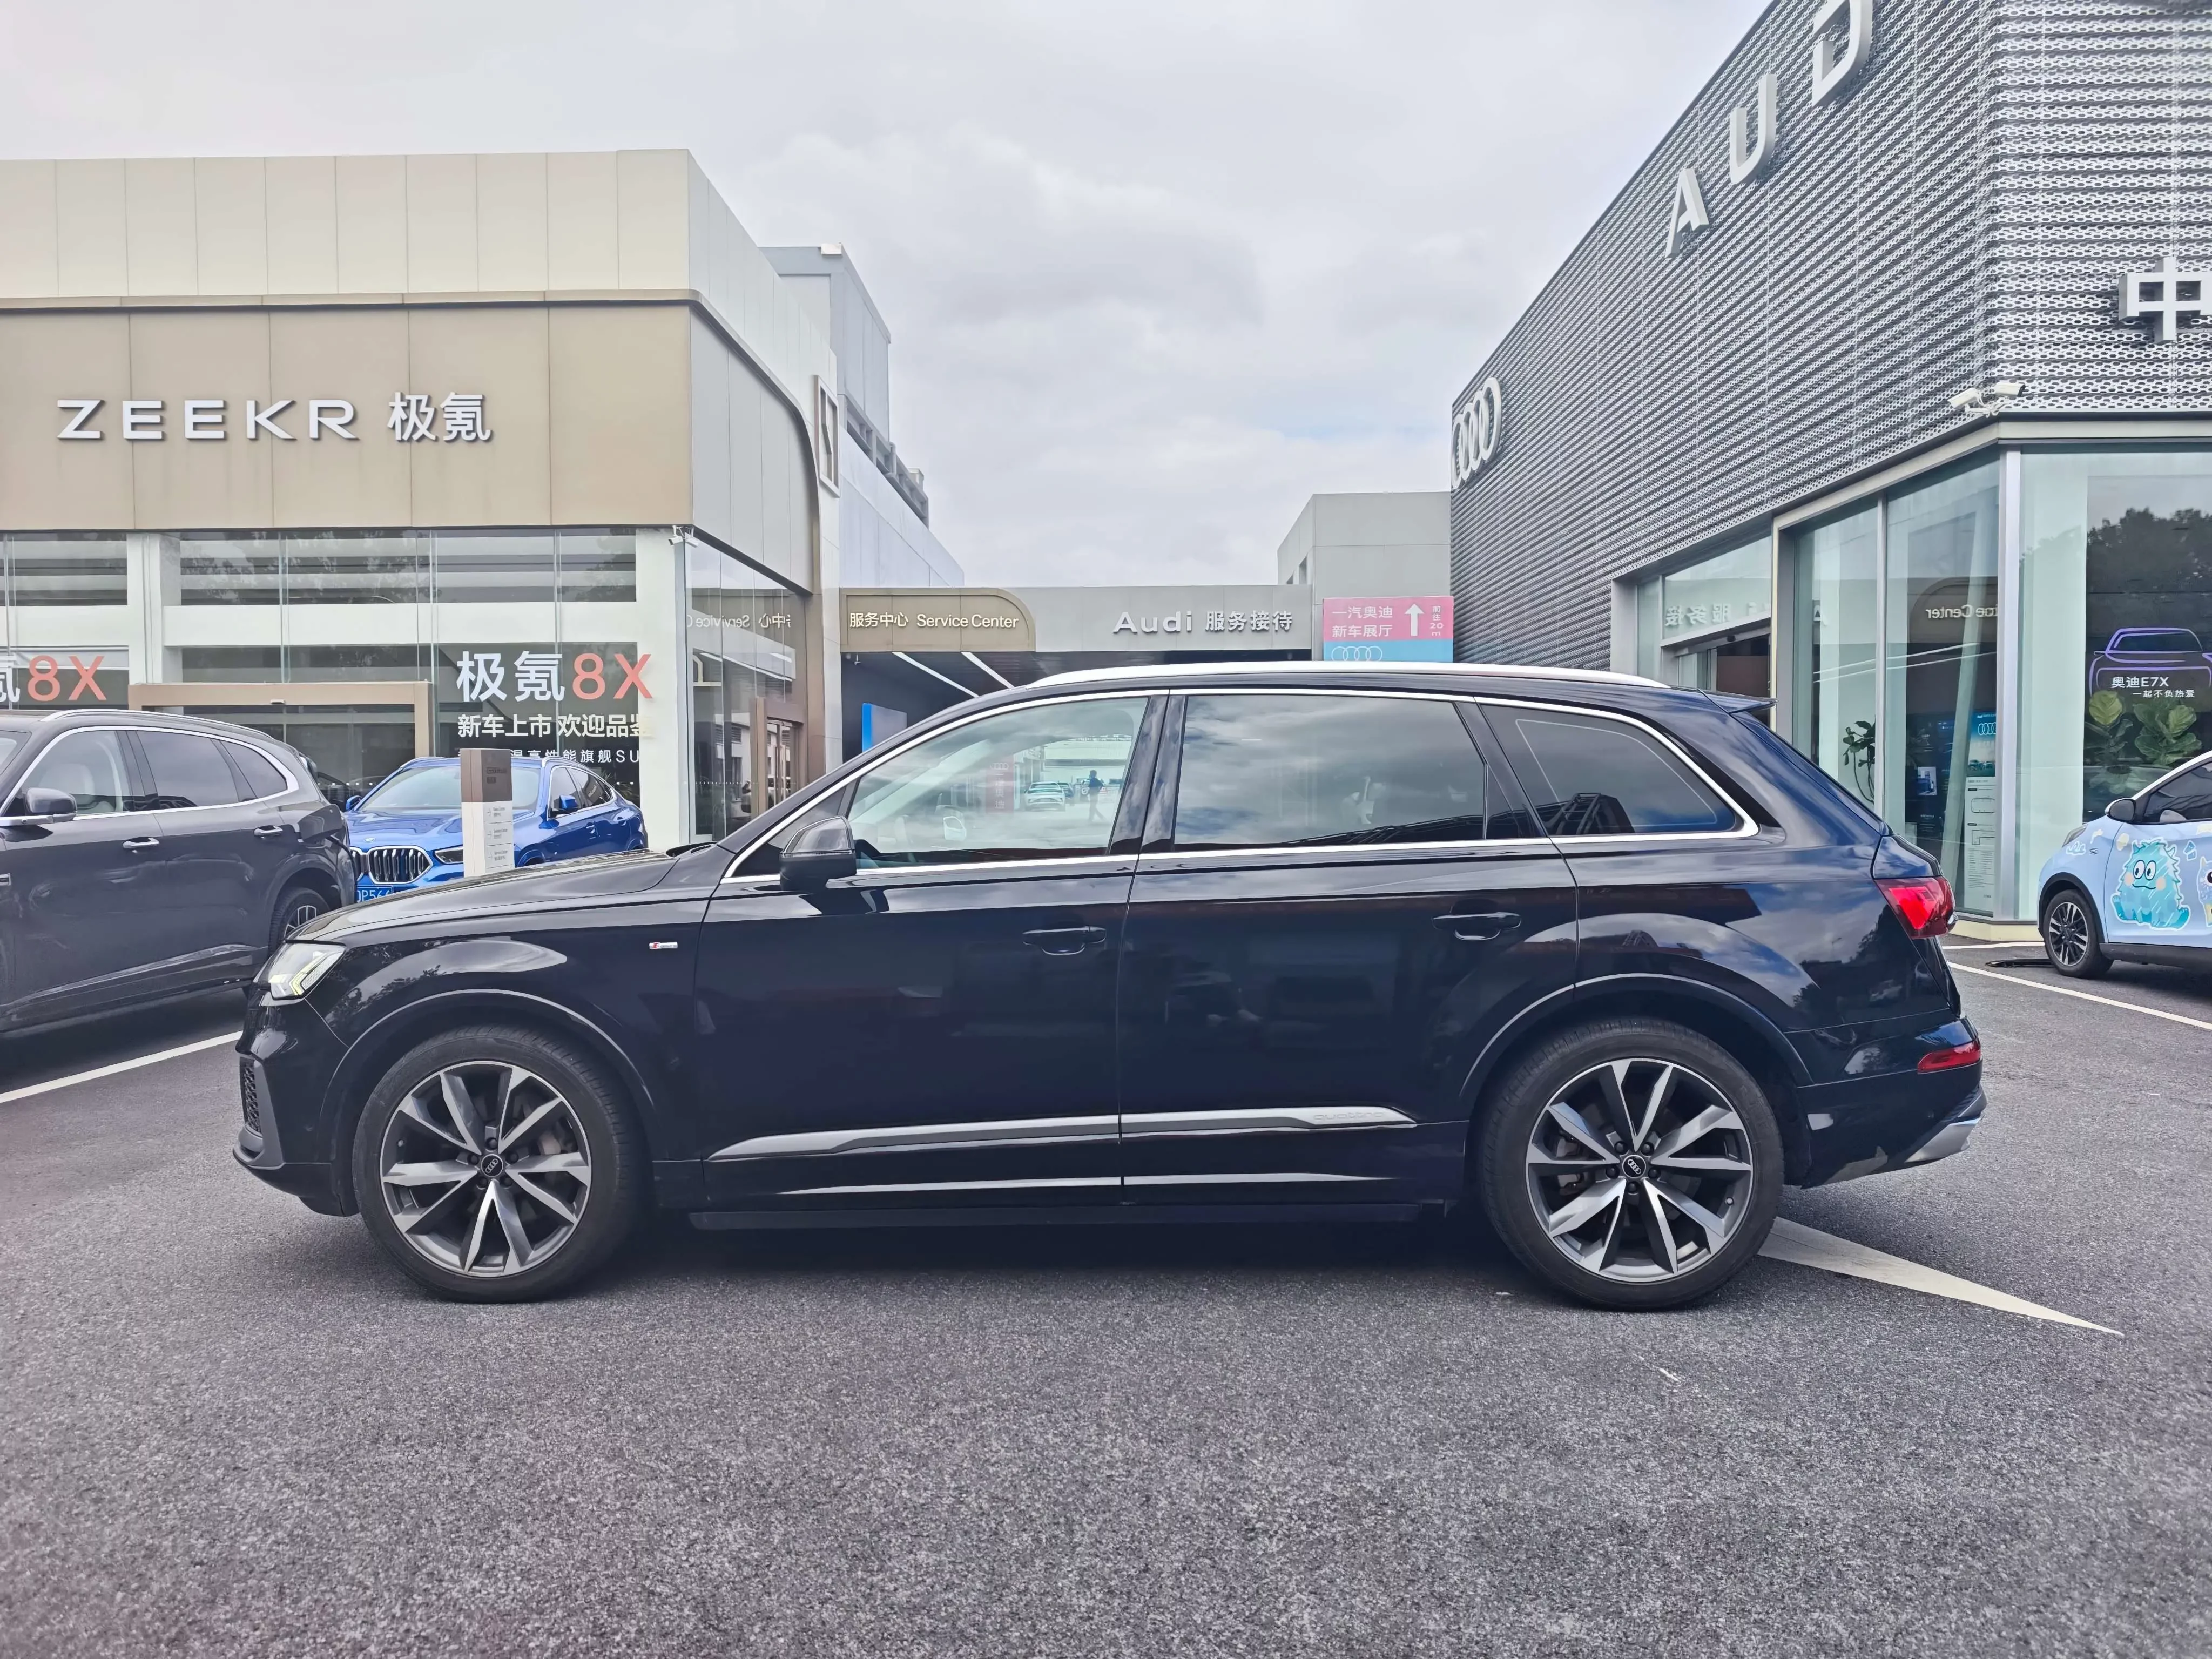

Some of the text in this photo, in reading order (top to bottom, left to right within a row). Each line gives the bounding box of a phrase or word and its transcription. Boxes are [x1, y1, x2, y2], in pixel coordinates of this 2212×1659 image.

[2120, 257, 2212, 342] 中
[57, 391, 493, 442] ZEEKR 极氪
[849, 612, 1020, 629] 服务中心 Service Center
[1112, 610, 1293, 634] Audi 服务接待
[1332, 605, 1393, 619] 一汽奥迪
[1331, 624, 1393, 638] 新车展厅
[456, 650, 653, 703] 极氪8X
[2110, 676, 2169, 689] 奥迪E7X
[2132, 689, 2195, 698] 一起不负热爱
[457, 713, 552, 738] 新车上市
